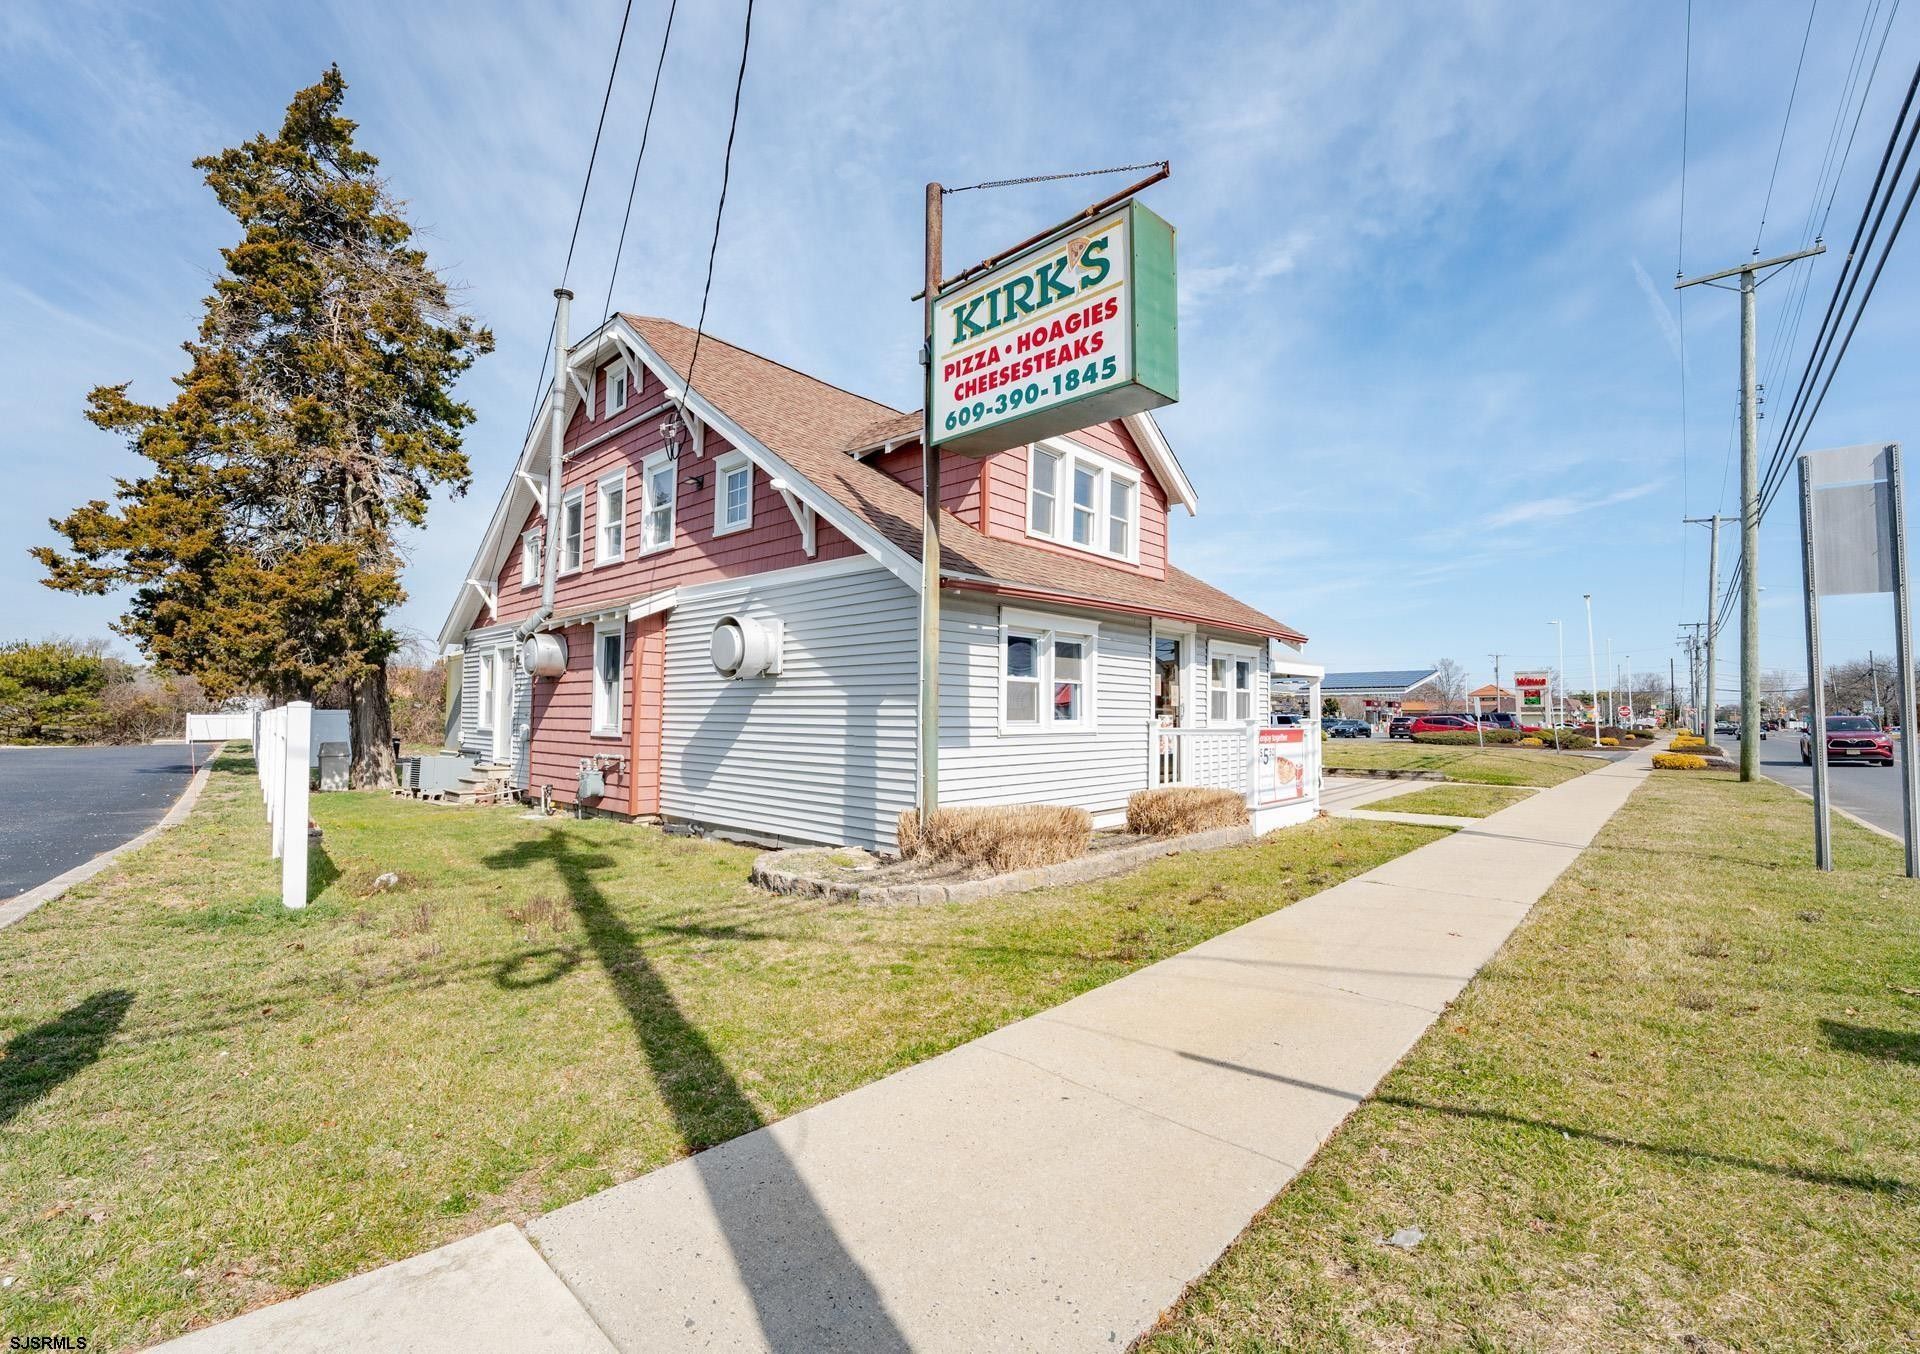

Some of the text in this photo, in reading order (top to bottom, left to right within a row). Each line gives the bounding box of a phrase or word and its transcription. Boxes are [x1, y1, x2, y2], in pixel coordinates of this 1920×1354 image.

[952, 236, 1111, 344] KIRK'S
[944, 297, 1118, 382] PIZZA HOAGIES
[954, 331, 1104, 401] CHEESESTEAKS
[945, 356, 1117, 430] 609-390-1845
